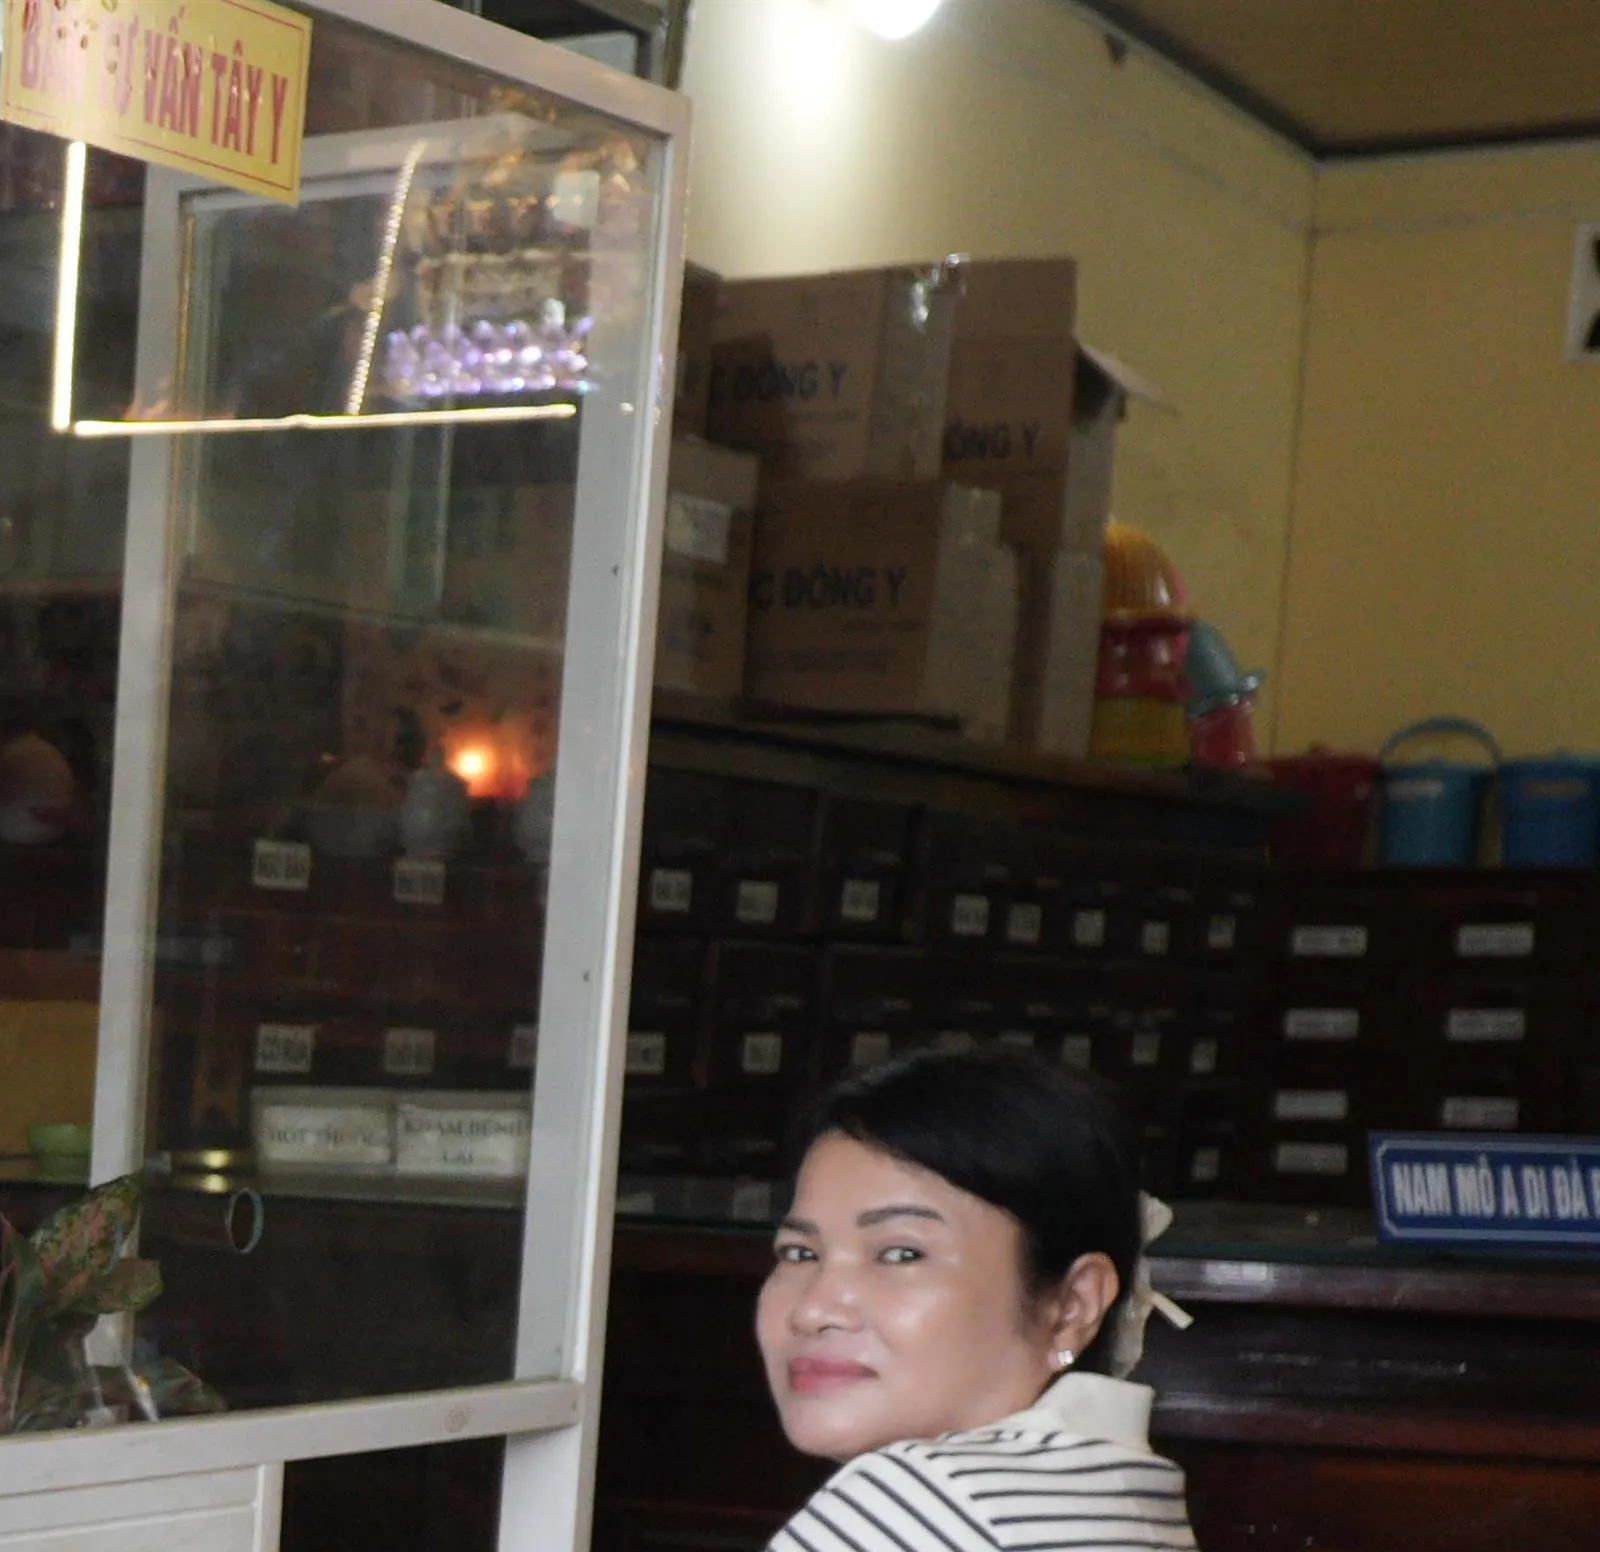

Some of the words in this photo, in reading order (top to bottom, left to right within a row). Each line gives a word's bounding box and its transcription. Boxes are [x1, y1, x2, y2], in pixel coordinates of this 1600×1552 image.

[144, 6, 204, 138] VẤN
[211, 39, 264, 157] TÂY
[271, 73, 288, 165] Y
[827, 360, 847, 397] Y
[1022, 420, 1040, 457] Y
[885, 566, 906, 604] Y
[1392, 1162, 1451, 1217] NAM
[1502, 1163, 1520, 1219] A
